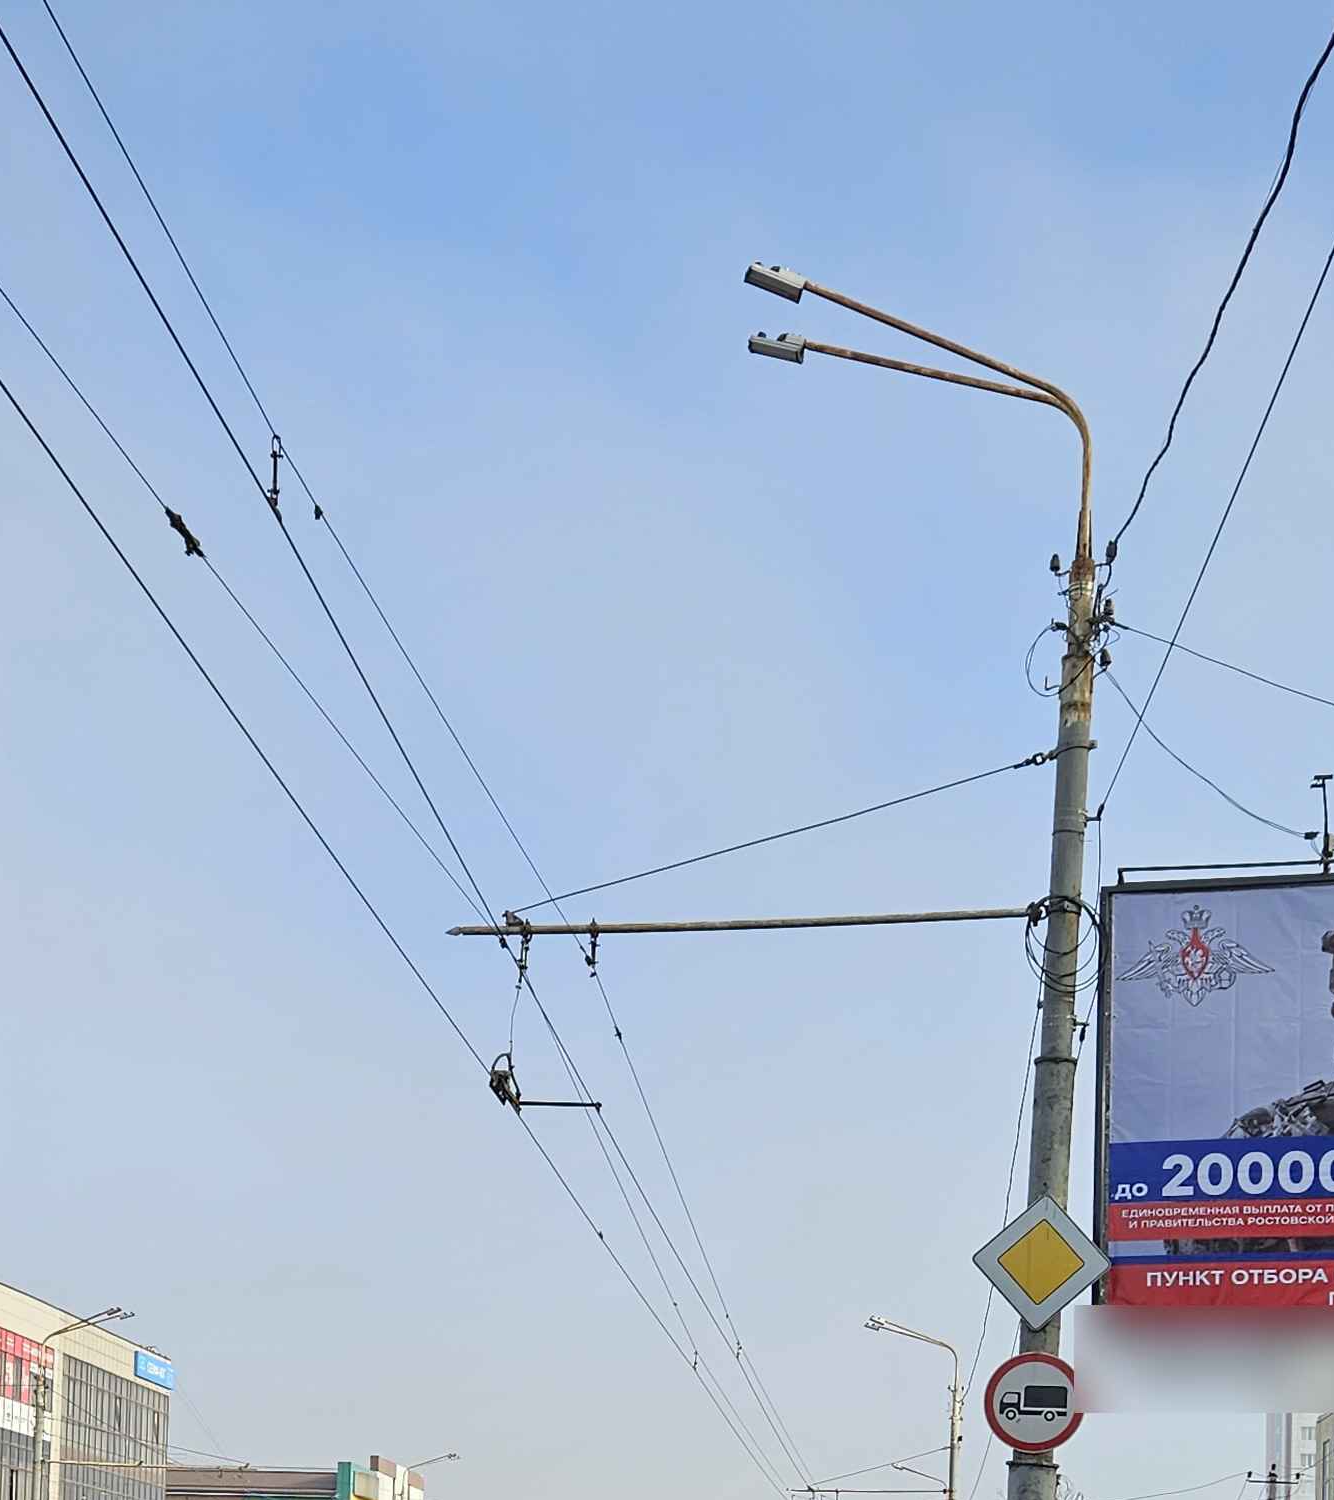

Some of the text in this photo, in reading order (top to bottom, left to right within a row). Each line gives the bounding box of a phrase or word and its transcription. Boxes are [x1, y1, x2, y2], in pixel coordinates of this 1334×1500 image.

[1122, 1206, 1240, 1218] ЕДИНОВРЕМЕННАЯ
[1243, 1204, 1303, 1214] ВЫПЛАТА
[1306, 1204, 1324, 1213] ОТ
[1141, 1217, 1245, 1229] ПРАВИТЕЛЬСТВА
[1247, 1213, 1334, 1226] РОСТОВСКОЙ
[1146, 1270, 1223, 1287] ПУНКТ
[1231, 1268, 1329, 1285] ОТБОРА
